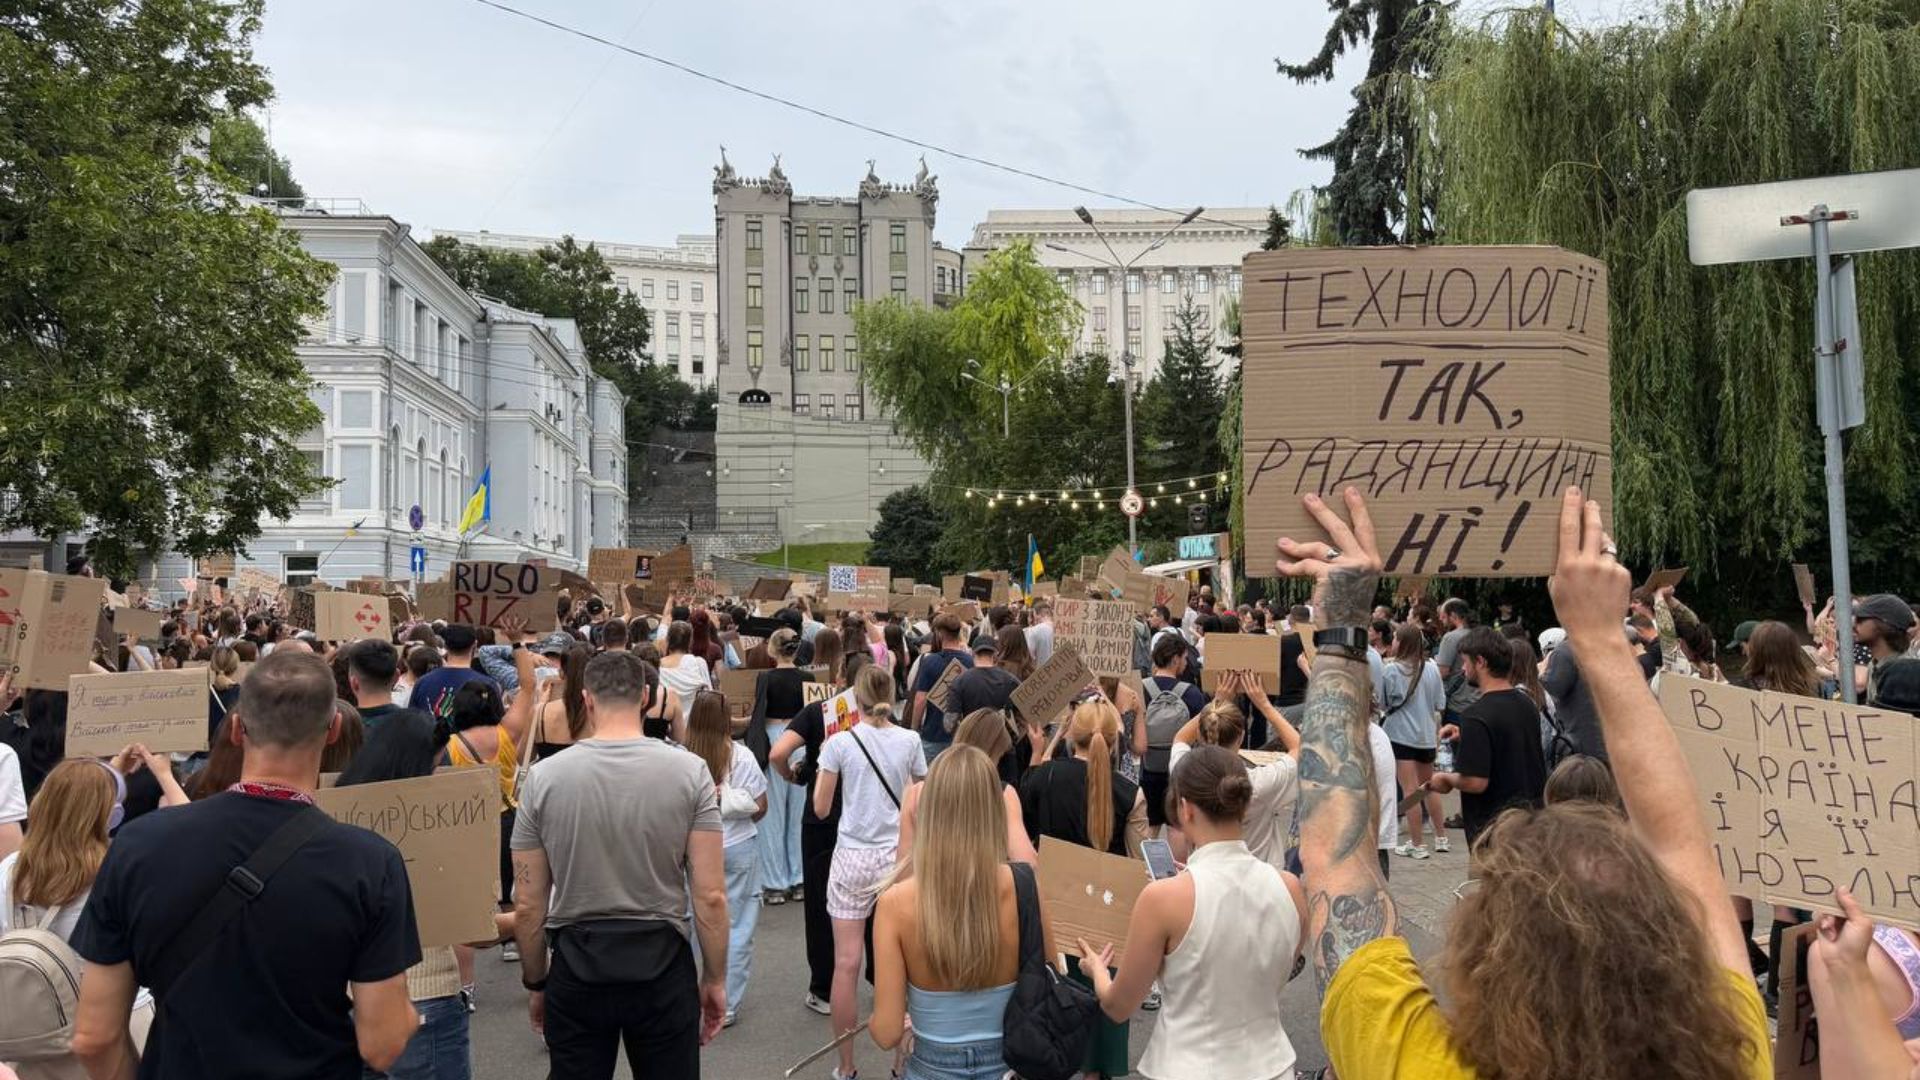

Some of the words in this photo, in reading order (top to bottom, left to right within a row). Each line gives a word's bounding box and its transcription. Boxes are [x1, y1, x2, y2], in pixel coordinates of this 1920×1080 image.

[1260, 264, 1597, 334] ТЕХНОЛОГІЇ
[1379, 358, 1523, 430] ТАК,
[1247, 437, 1598, 500] РАДЯНЩИНА
[455, 562, 538, 595] RUSO
[1081, 623, 1132, 640] ПРИБРАВ
[1093, 640, 1132, 657] АРМІЮ
[1690, 688, 1723, 731] В
[1750, 699, 1887, 765] МЕНЕ
[1722, 747, 1920, 831] КРАЇНА
[1759, 808, 1789, 845] Я
[1826, 813, 1880, 857] ЇЇ
